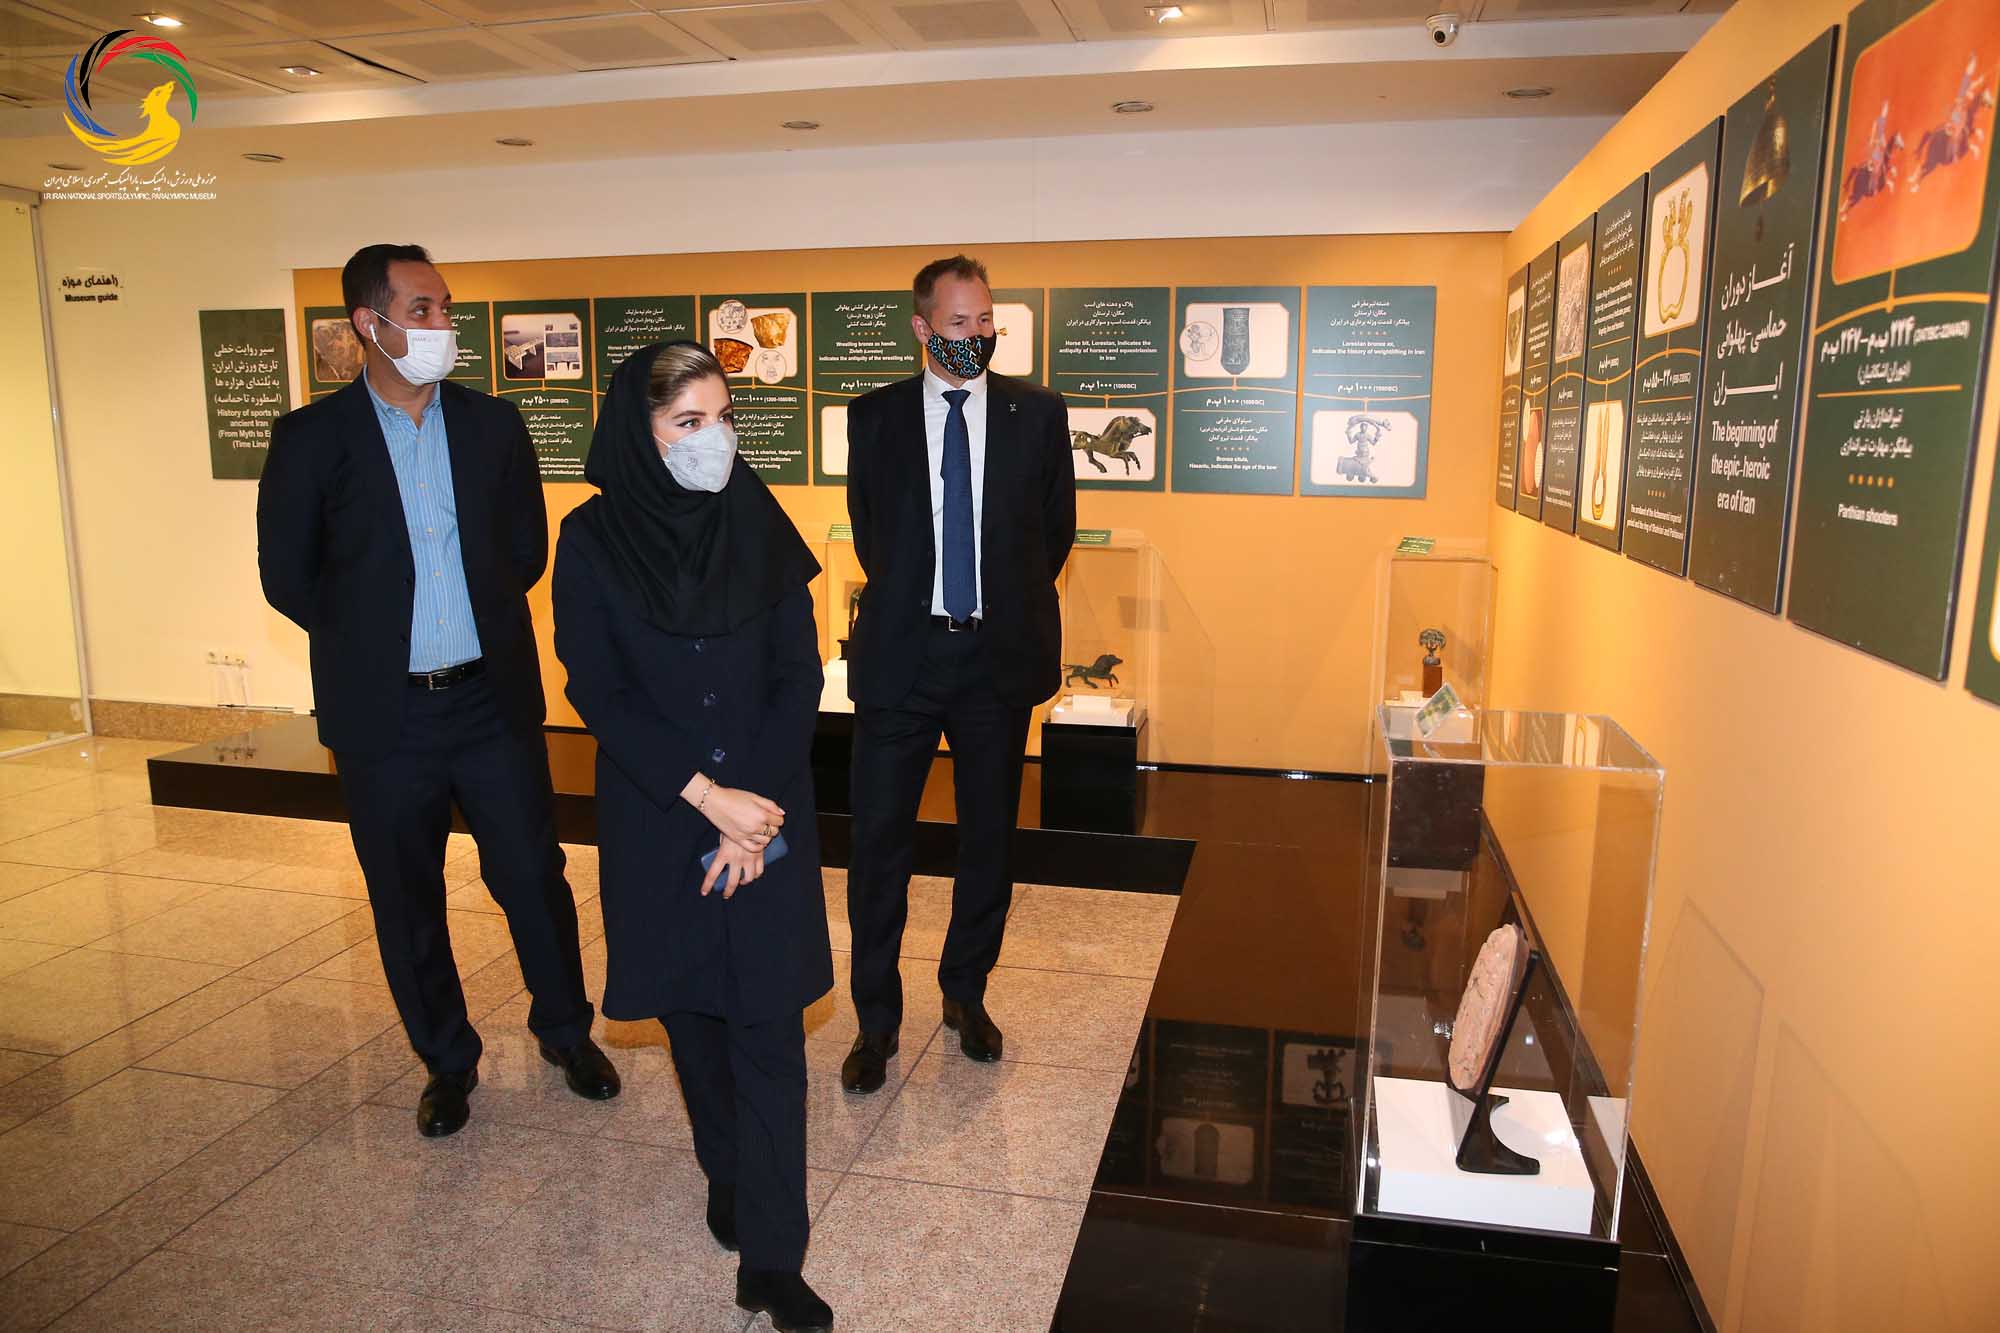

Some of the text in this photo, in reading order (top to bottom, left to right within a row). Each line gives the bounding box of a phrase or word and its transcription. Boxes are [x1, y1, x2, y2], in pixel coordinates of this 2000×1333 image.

[63, 275, 118, 288] راهنمای موزه
[1721, 243, 1794, 310] آغاز دوران
[98, 293, 118, 303] guide
[215, 344, 274, 357] سیر روایت خطی
[235, 361, 257, 373] ورزش
[258, 360, 278, 373] تاریخ
[215, 378, 223, 386] ها
[225, 378, 244, 389] هزاره
[272, 380, 279, 388] به
[857, 380, 871, 388] ۱۰۰۰
[1080, 383, 1095, 391] پ.م
[1097, 380, 1112, 389] ۱۰۰۰
[1356, 383, 1372, 391] ۱۰۰۰
[1714, 362, 1783, 406] ایران
[1338, 385, 1353, 393] پ.م
[215, 394, 282, 406] (اسطوره تا حماسه)
[1207, 399, 1221, 407] پ.م
[1224, 396, 1239, 405] ۱۰۰۰
[217, 409, 241, 418] History
[251, 410, 272, 418] sports
[218, 430, 238, 439] (From
[239, 430, 255, 439] Myth
[1712, 419, 1779, 448] The beginning of
[252, 441, 269, 449] Line)
[1711, 454, 1770, 480] the epic-heroic
[1717, 490, 1755, 514] era of Iran
[1838, 504, 1898, 526] Parthian shooters
